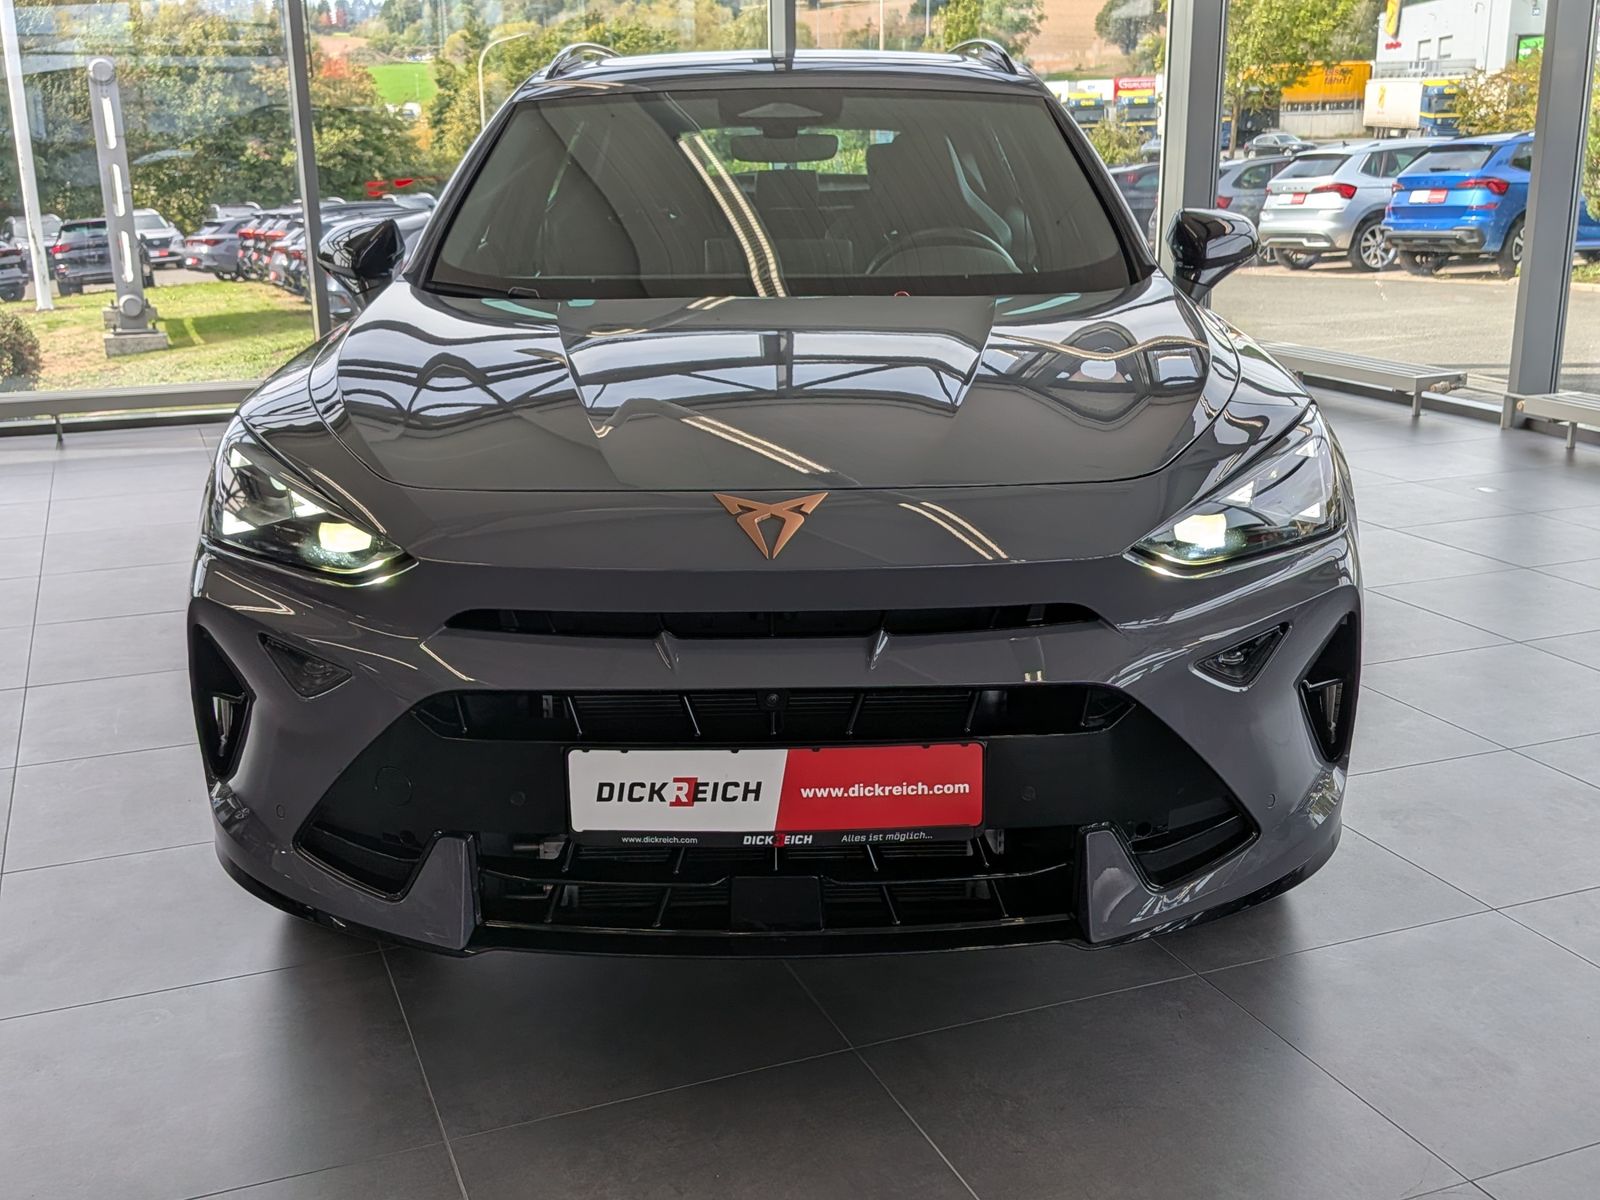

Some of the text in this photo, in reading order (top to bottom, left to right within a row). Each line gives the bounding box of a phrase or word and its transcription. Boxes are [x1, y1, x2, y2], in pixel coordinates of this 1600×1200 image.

[596, 778, 762, 804] DICKREICH
[799, 782, 970, 798] www.dickreich.com
[621, 836, 699, 845] www.dickreich.com
[842, 831, 934, 843] Alles ist möglich...
